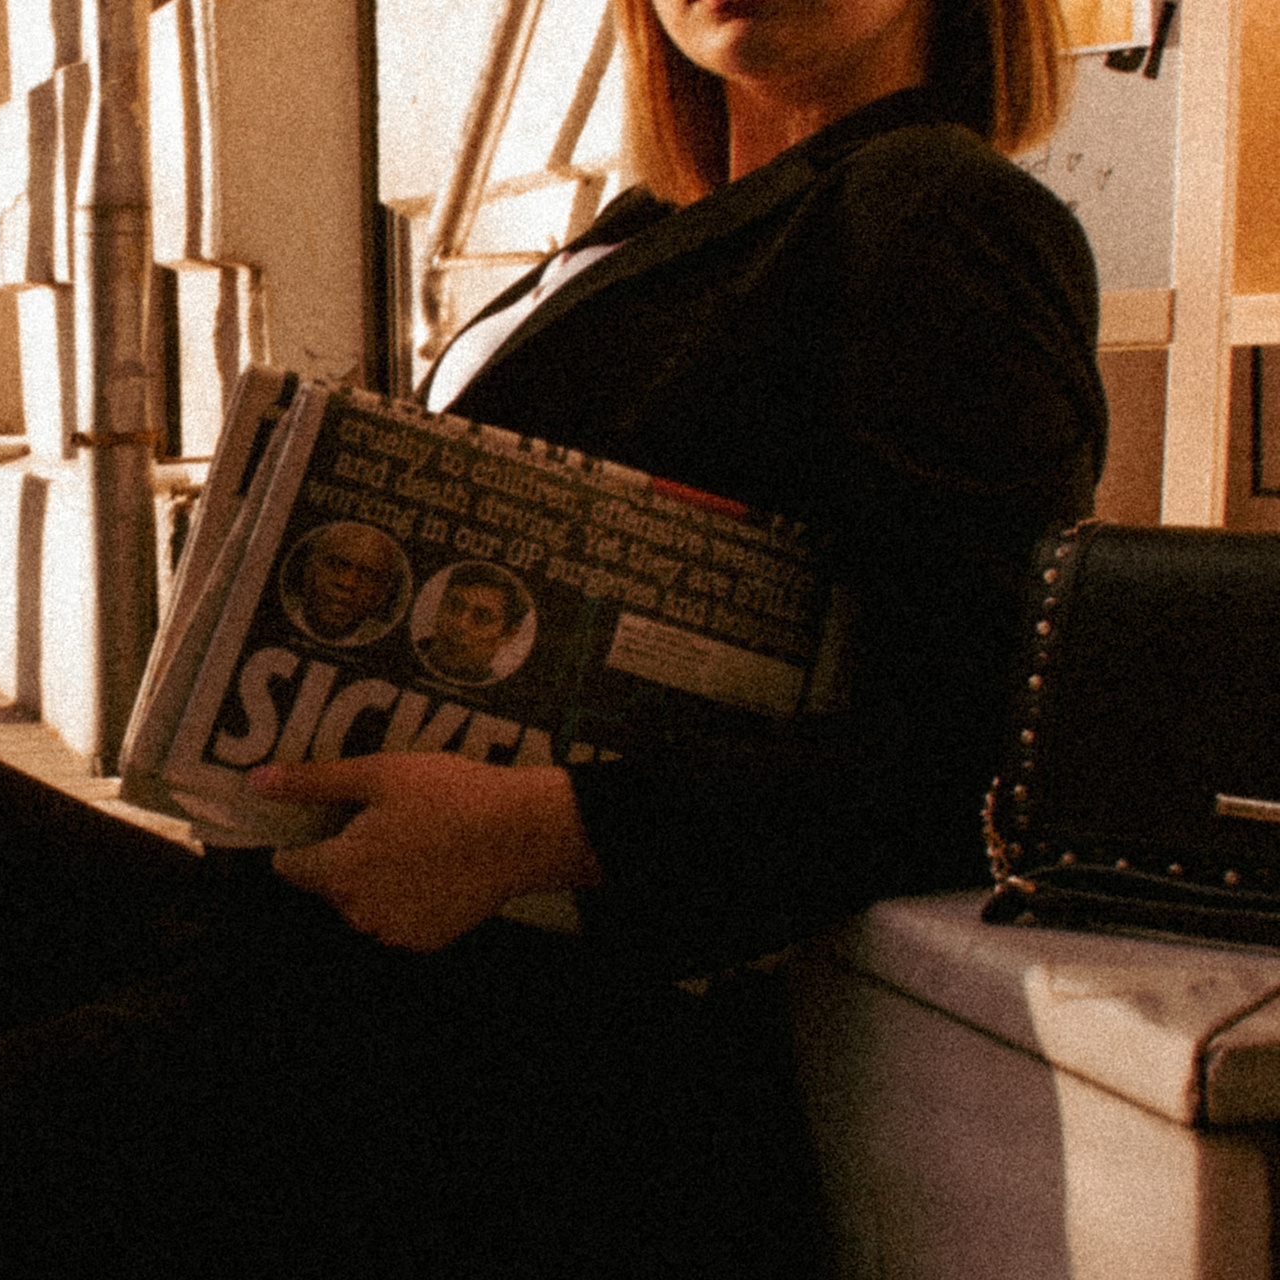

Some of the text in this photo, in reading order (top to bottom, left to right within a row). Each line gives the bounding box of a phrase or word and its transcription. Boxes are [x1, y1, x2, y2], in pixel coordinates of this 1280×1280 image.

[333, 452, 392, 488] and
[438, 445, 467, 475] to
[420, 510, 450, 541] in
[453, 525, 504, 556] our
